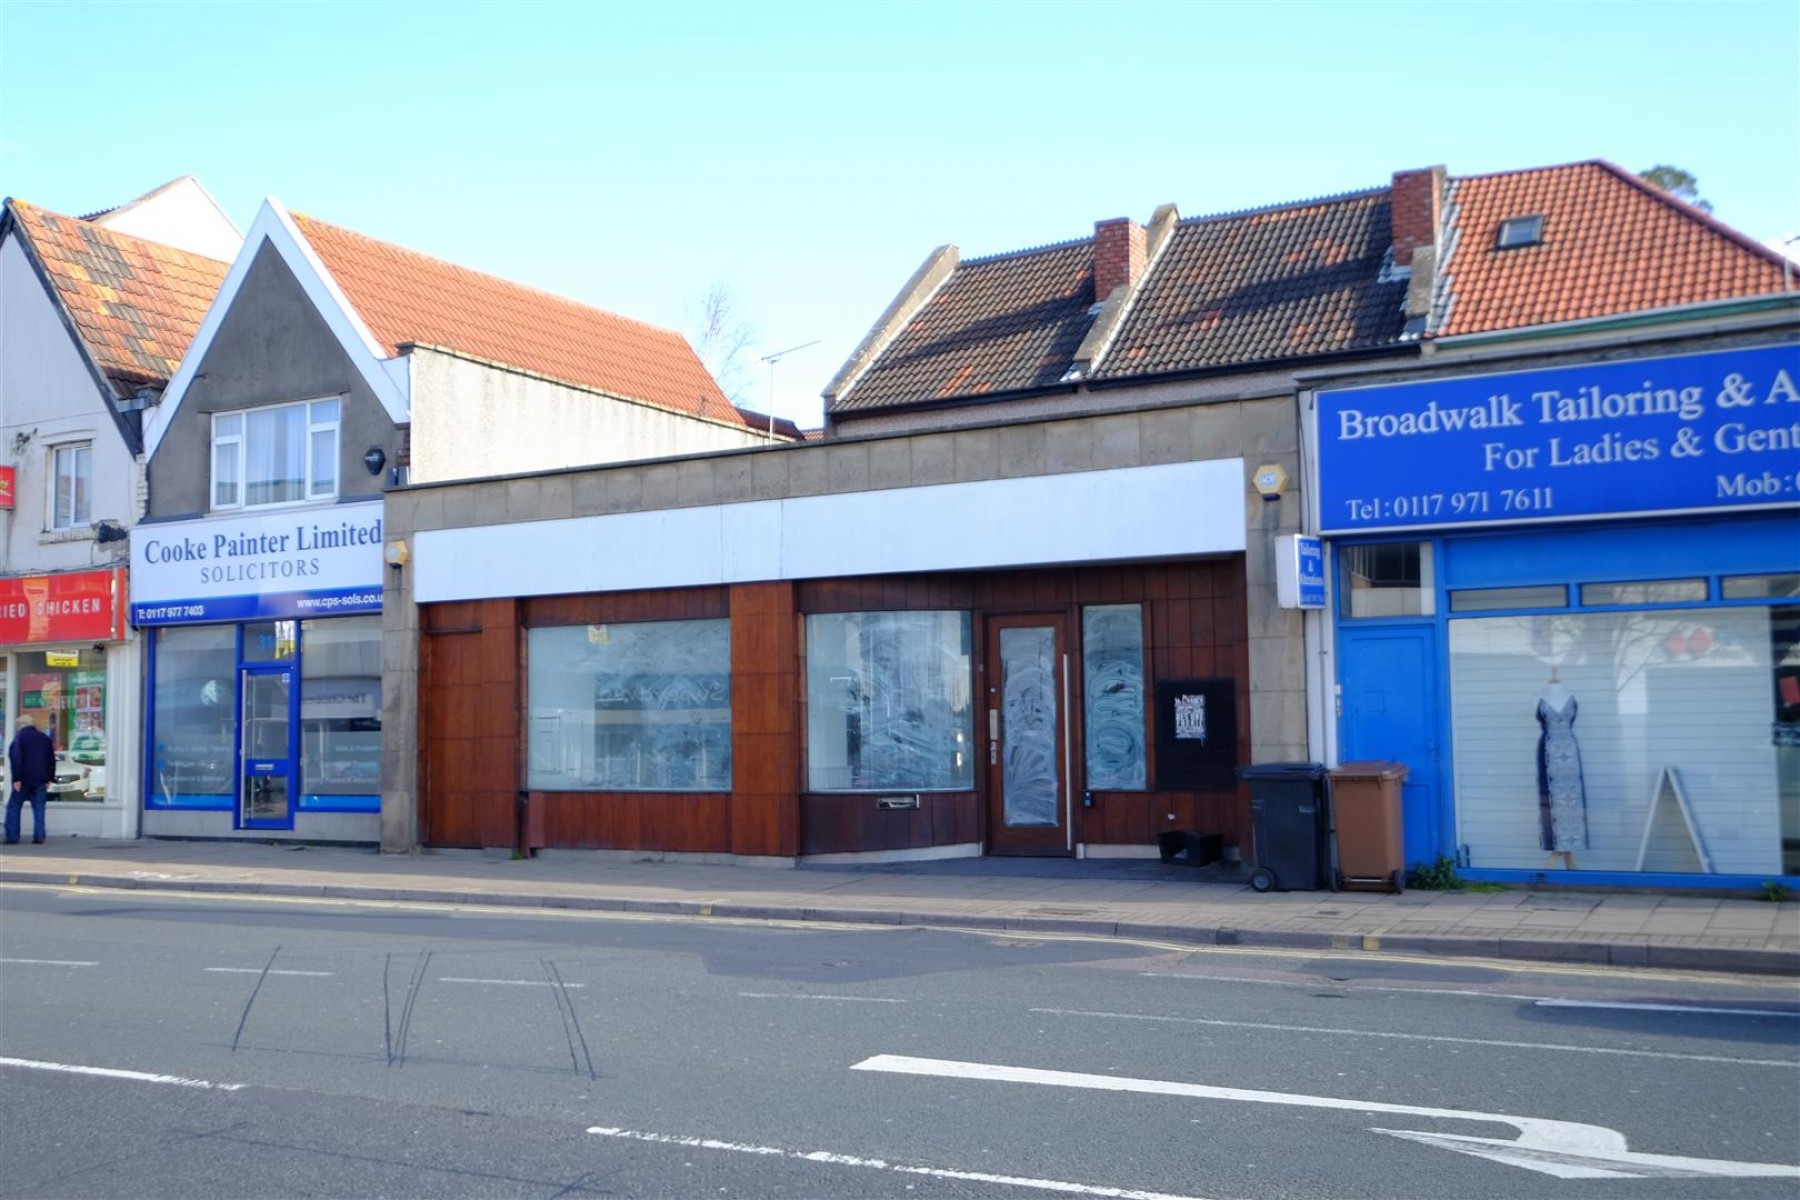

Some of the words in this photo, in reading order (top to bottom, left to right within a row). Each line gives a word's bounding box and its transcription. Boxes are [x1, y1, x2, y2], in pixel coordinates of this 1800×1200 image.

[1336, 394, 1524, 440] Broadwalk
[1531, 380, 1704, 421] Tailoring
[1715, 371, 1755, 409] &
[1762, 367, 1800, 405] A
[1483, 442, 1539, 471] For
[1549, 431, 1660, 467] Ladies
[1670, 426, 1704, 458] &
[1713, 421, 1800, 454] Gent
[1450, 490, 1489, 514] 971
[1500, 487, 1552, 512] 7611
[144, 537, 207, 565] Cooke
[213, 532, 290, 559] Painter
[295, 519, 382, 551] Limited
[200, 558, 320, 584] SOLICITORS
[35, 597, 101, 617] CHICKEN
[146, 607, 166, 619] 0117
[167, 605, 182, 618] 977
